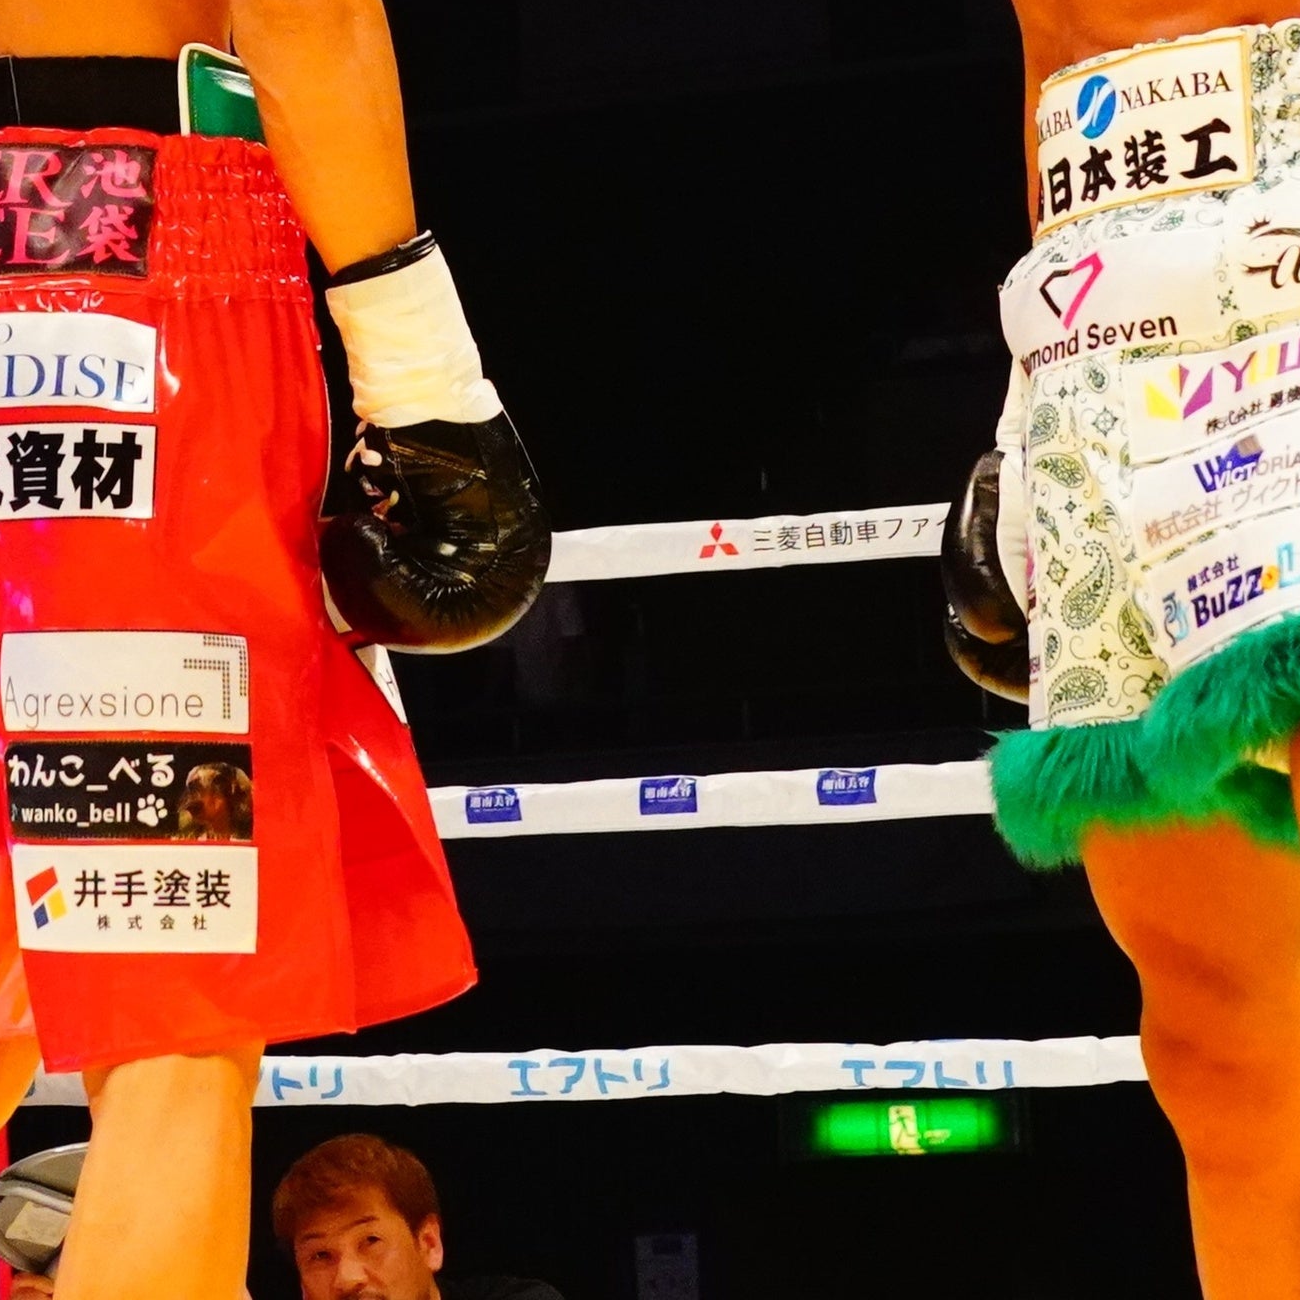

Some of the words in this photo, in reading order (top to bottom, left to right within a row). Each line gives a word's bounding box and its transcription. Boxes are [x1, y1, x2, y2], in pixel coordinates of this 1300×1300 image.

[1120, 70, 1234, 113] NAKABA
[1038, 118, 1238, 223] 日本装工
[81, 151, 147, 263] 池袋
[1087, 316, 1178, 350] Seven
[1144, 496, 1223, 547] 株式会社
[5, 676, 204, 728] Agrexsione
[21, 802, 131, 828] wanko_bell
[74, 868, 232, 909] 井手塗装
[97, 914, 209, 931] 株式会社
[507, 1057, 671, 1096] エアトリ
